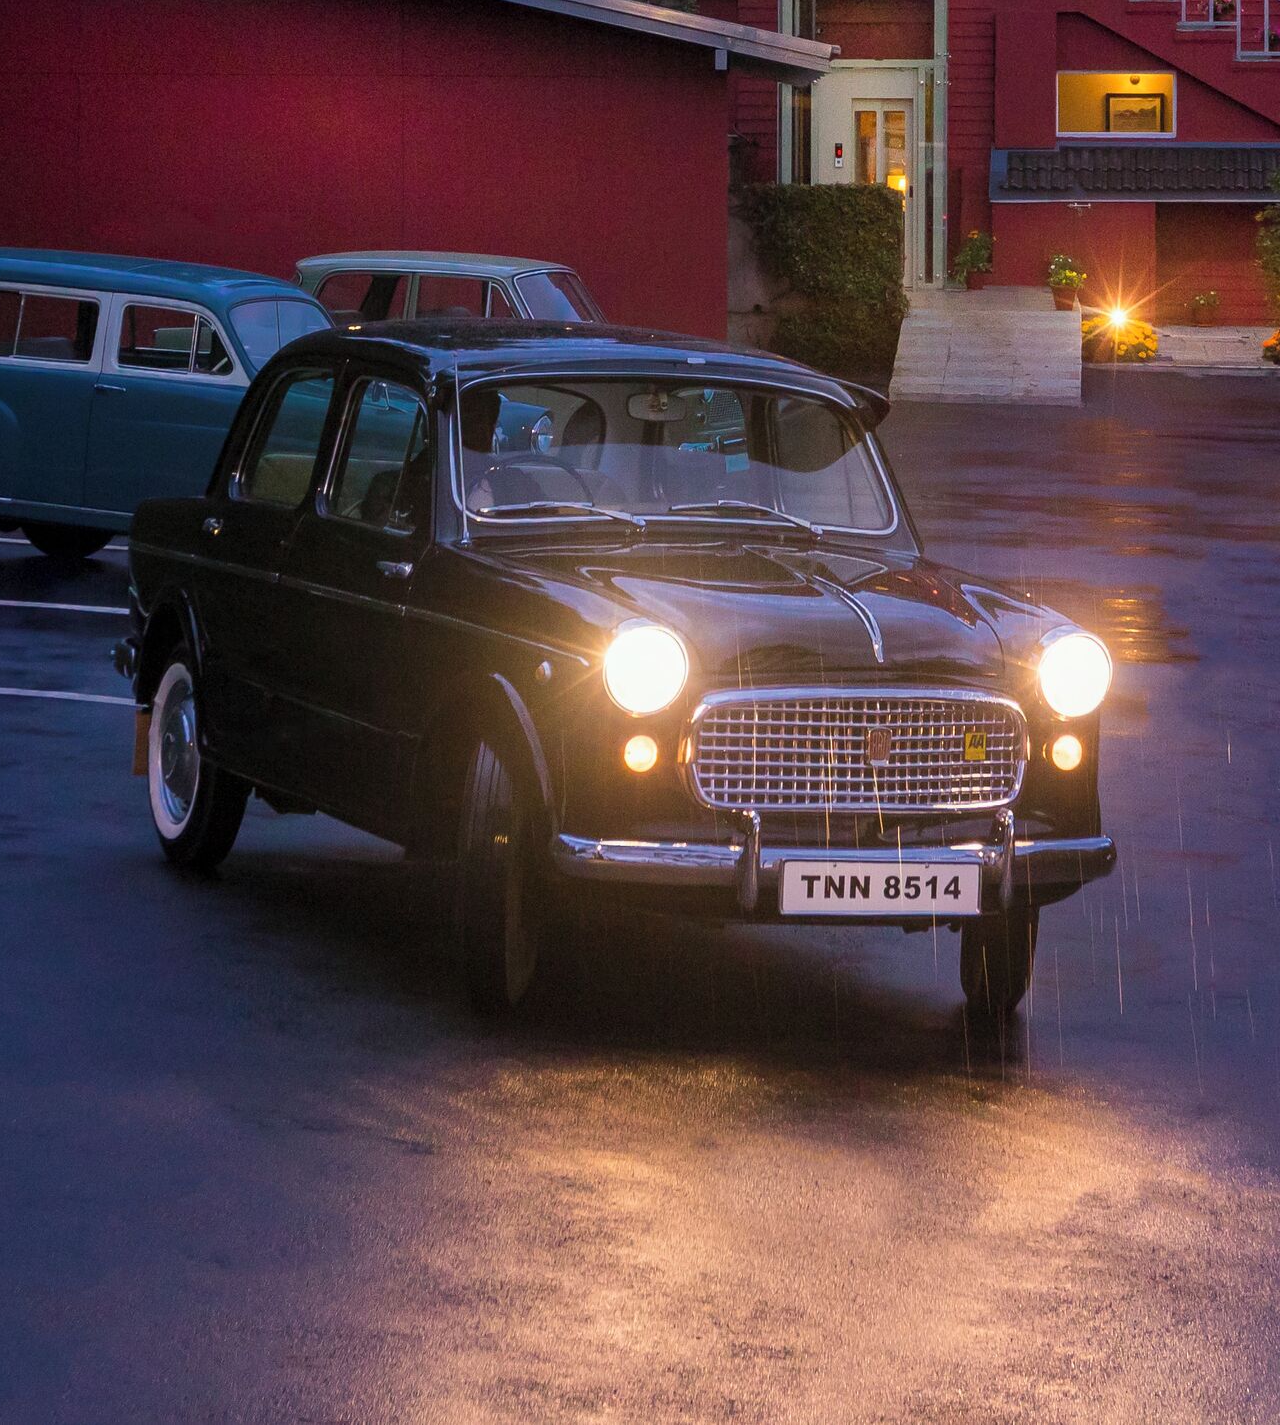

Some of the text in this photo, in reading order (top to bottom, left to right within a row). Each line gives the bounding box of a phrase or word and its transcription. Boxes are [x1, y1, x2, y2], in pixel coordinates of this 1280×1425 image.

[967, 734, 984, 749] AA
[801, 875, 961, 899] TNN 8514
